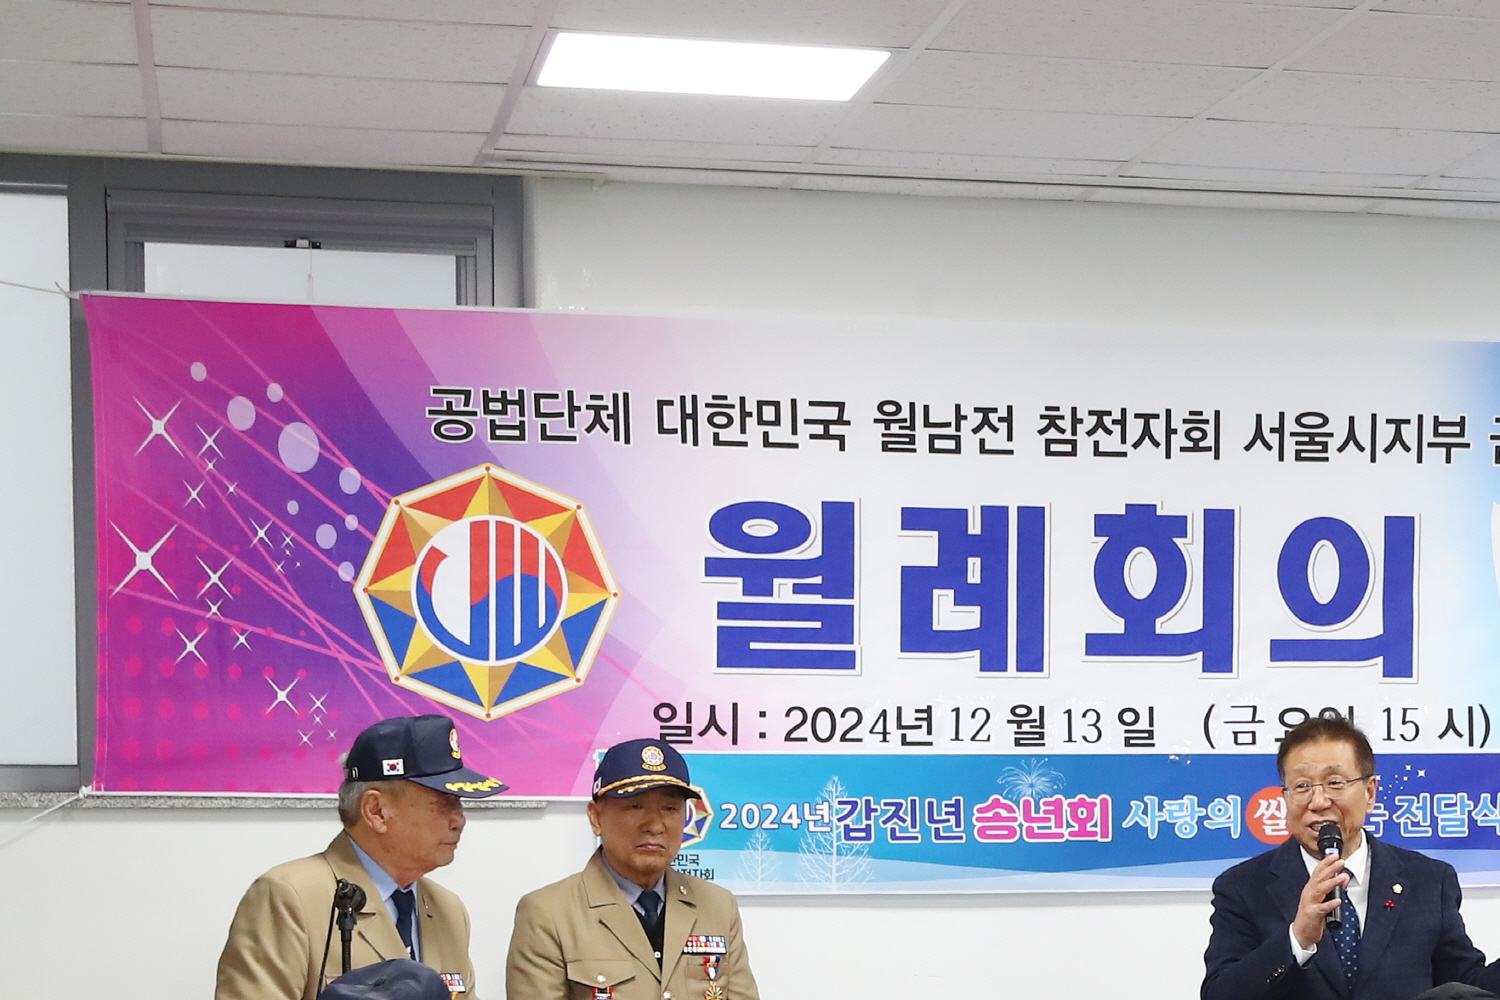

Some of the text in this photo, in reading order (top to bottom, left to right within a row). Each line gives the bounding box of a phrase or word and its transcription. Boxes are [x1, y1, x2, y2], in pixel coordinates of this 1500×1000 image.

[427, 387, 632, 446] 공법단체
[656, 394, 851, 453] 대한민국
[873, 400, 1015, 456] 월남전
[1037, 405, 1222, 461] 참전자회
[1243, 411, 1471, 465] 서울시지부
[703, 500, 1414, 679] 월례회의
[652, 702, 739, 745] 일시
[784, 705, 933, 746] 2024년
[951, 707, 991, 742] 12
[1006, 704, 1046, 747] 월
[1063, 708, 1102, 744] 13
[1117, 706, 1156, 748] 일
[1383, 707, 1420, 742] 15
[1437, 704, 1491, 749] 시)
[973, 795, 1113, 843] 송년회
[1122, 795, 1242, 840] 사랑의
